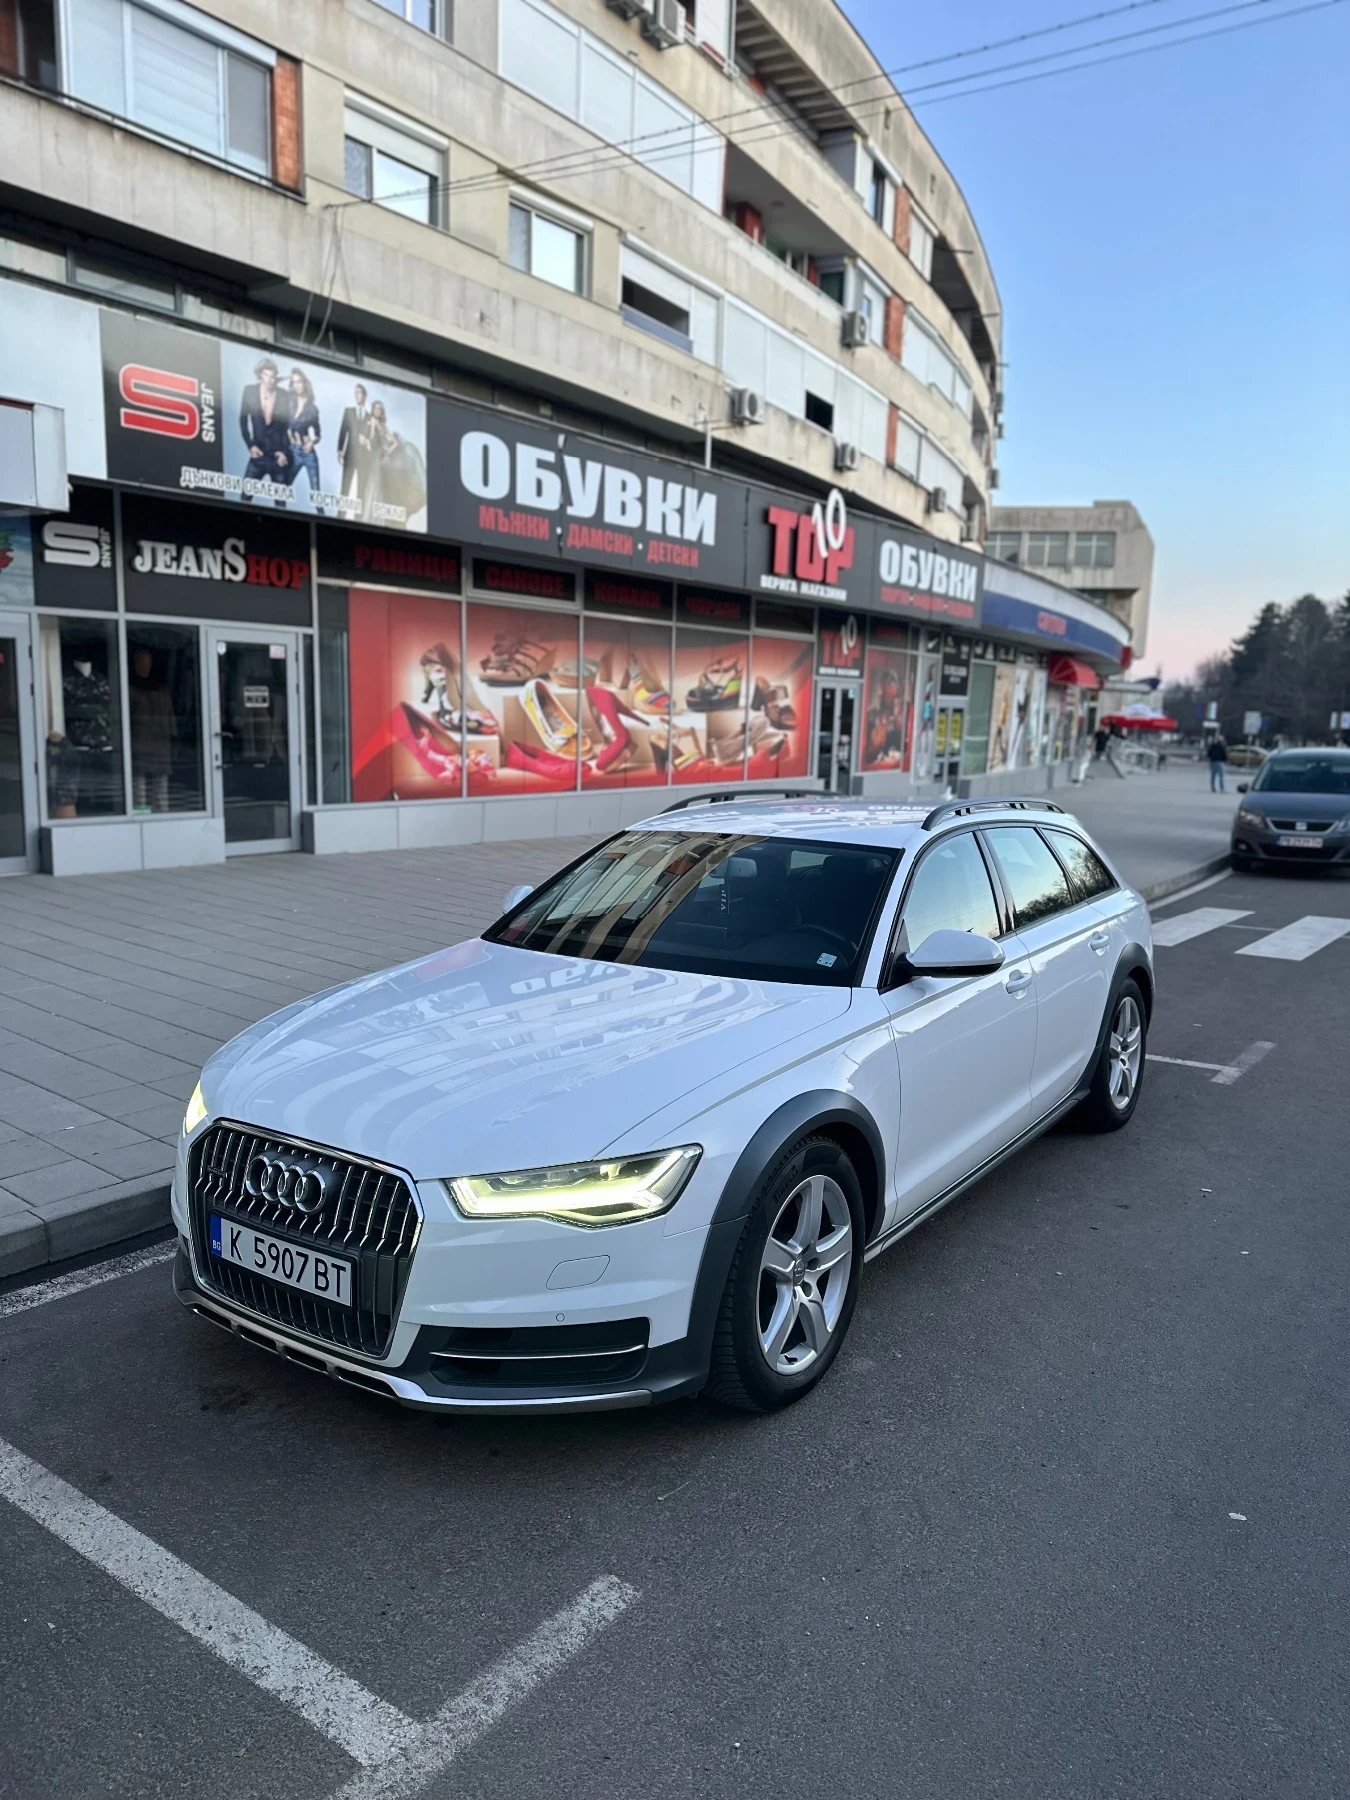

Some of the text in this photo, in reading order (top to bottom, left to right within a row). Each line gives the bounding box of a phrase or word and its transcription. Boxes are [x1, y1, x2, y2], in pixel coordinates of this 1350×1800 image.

[119, 363, 199, 440] S
[201, 382, 215, 443] JEANS
[181, 467, 242, 493] ДЪНКОВИ
[244, 478, 294, 501] ОБЛЕКЛА
[460, 430, 717, 546] ОБУВКИ
[43, 521, 100, 568] S
[99, 527, 112, 568] JEANS
[478, 504, 699, 568] МЪЖКИ ДАМСКИ ДЕТСКИ
[768, 504, 855, 584] TOP
[812, 488, 847, 558] 10
[760, 574, 798, 593] ВЕРИГА
[879, 539, 978, 602] ОБУВКИ
[212, 1239, 221, 1251] BG
[230, 1227, 347, 1297] K 5907 BT
